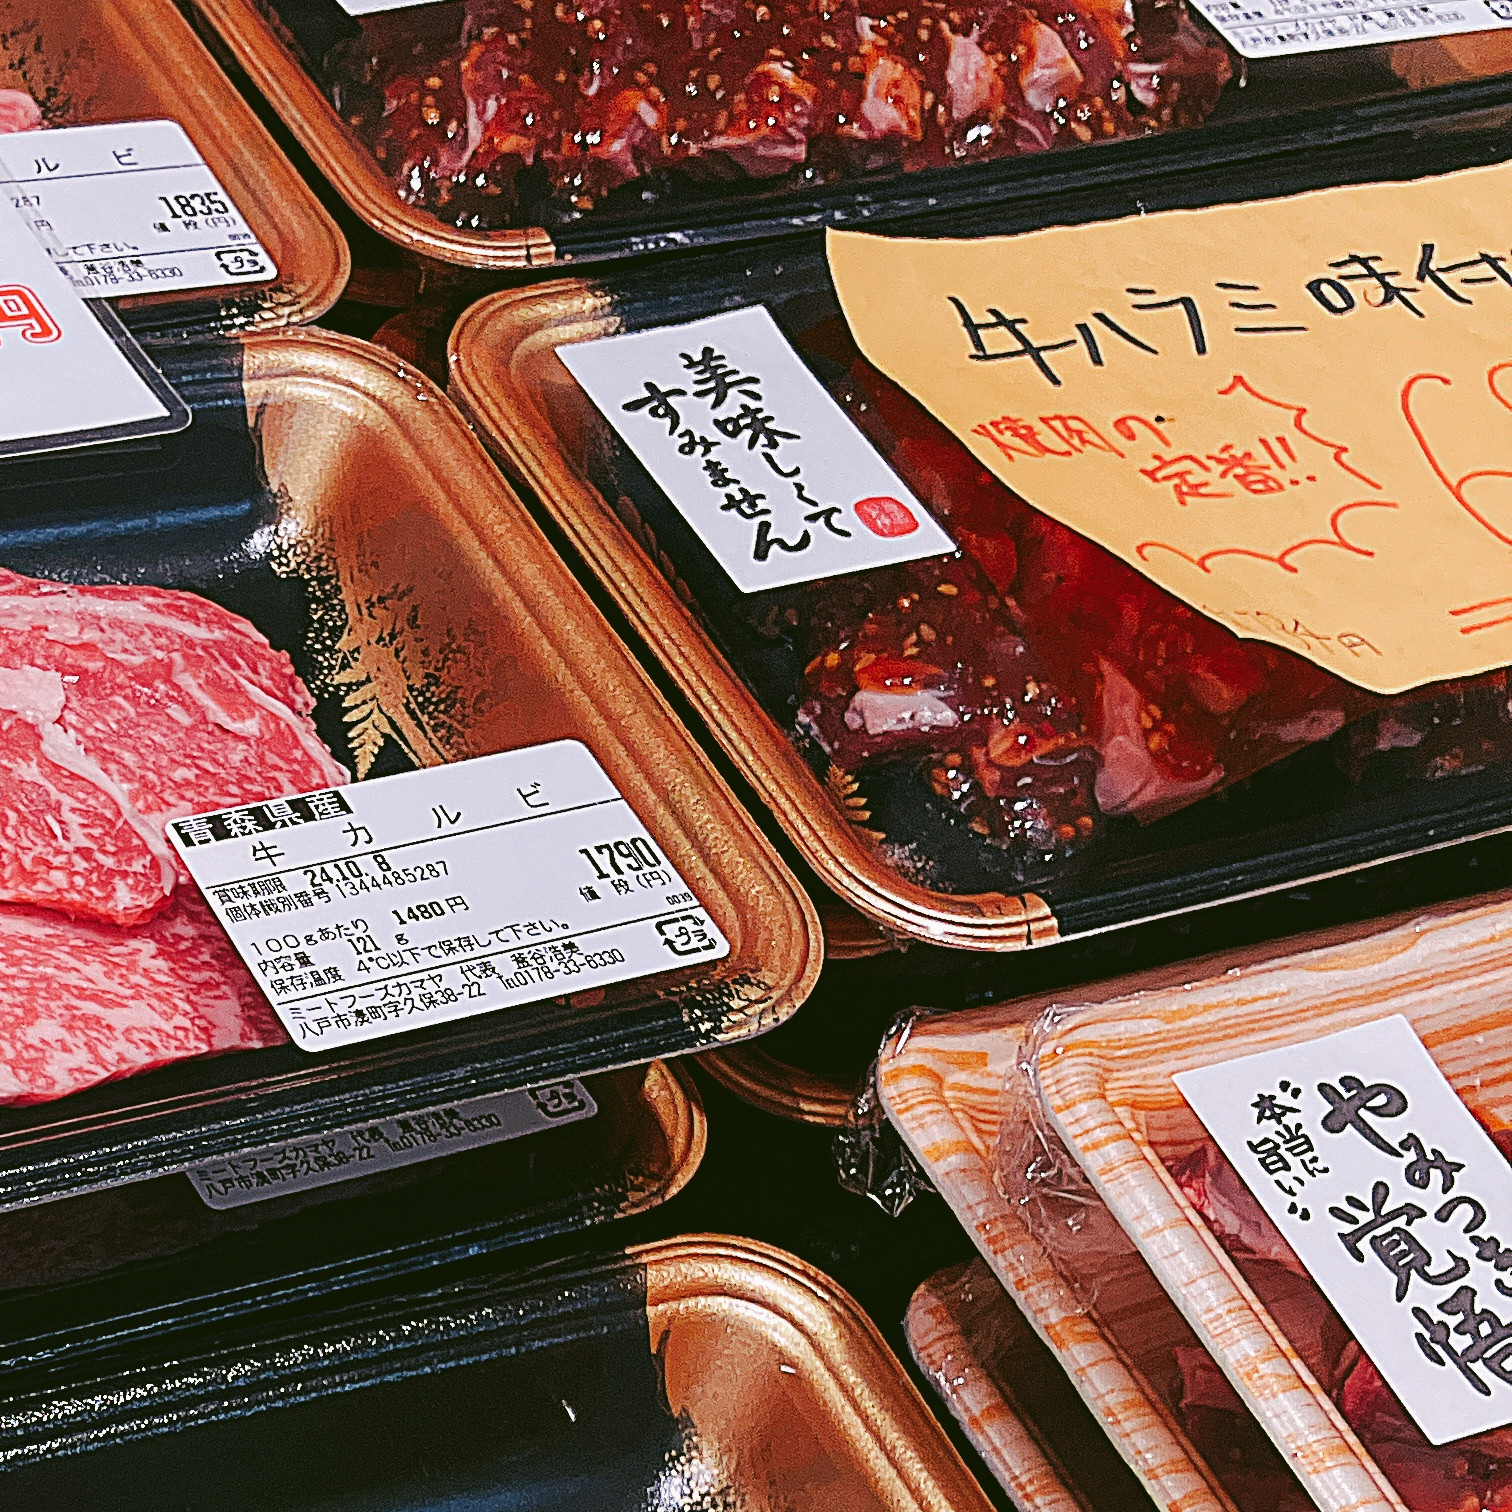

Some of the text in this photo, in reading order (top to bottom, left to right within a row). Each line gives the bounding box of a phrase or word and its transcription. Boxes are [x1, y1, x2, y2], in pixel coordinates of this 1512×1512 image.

[158, 191, 229, 219] 1835
[678, 346, 853, 538] 美味しくて
[971, 413, 1173, 463] 焼肉の
[621, 381, 811, 562] すみません
[178, 791, 347, 846] 青森県産
[335, 860, 450, 899] 1344485287
[578, 837, 662, 880] 1790
[212, 876, 288, 906] 賞味期限
[256, 950, 317, 978] 内容量
[346, 934, 382, 956] 121
[459, 960, 499, 982] 代表
[269, 965, 346, 996] 保存温度
